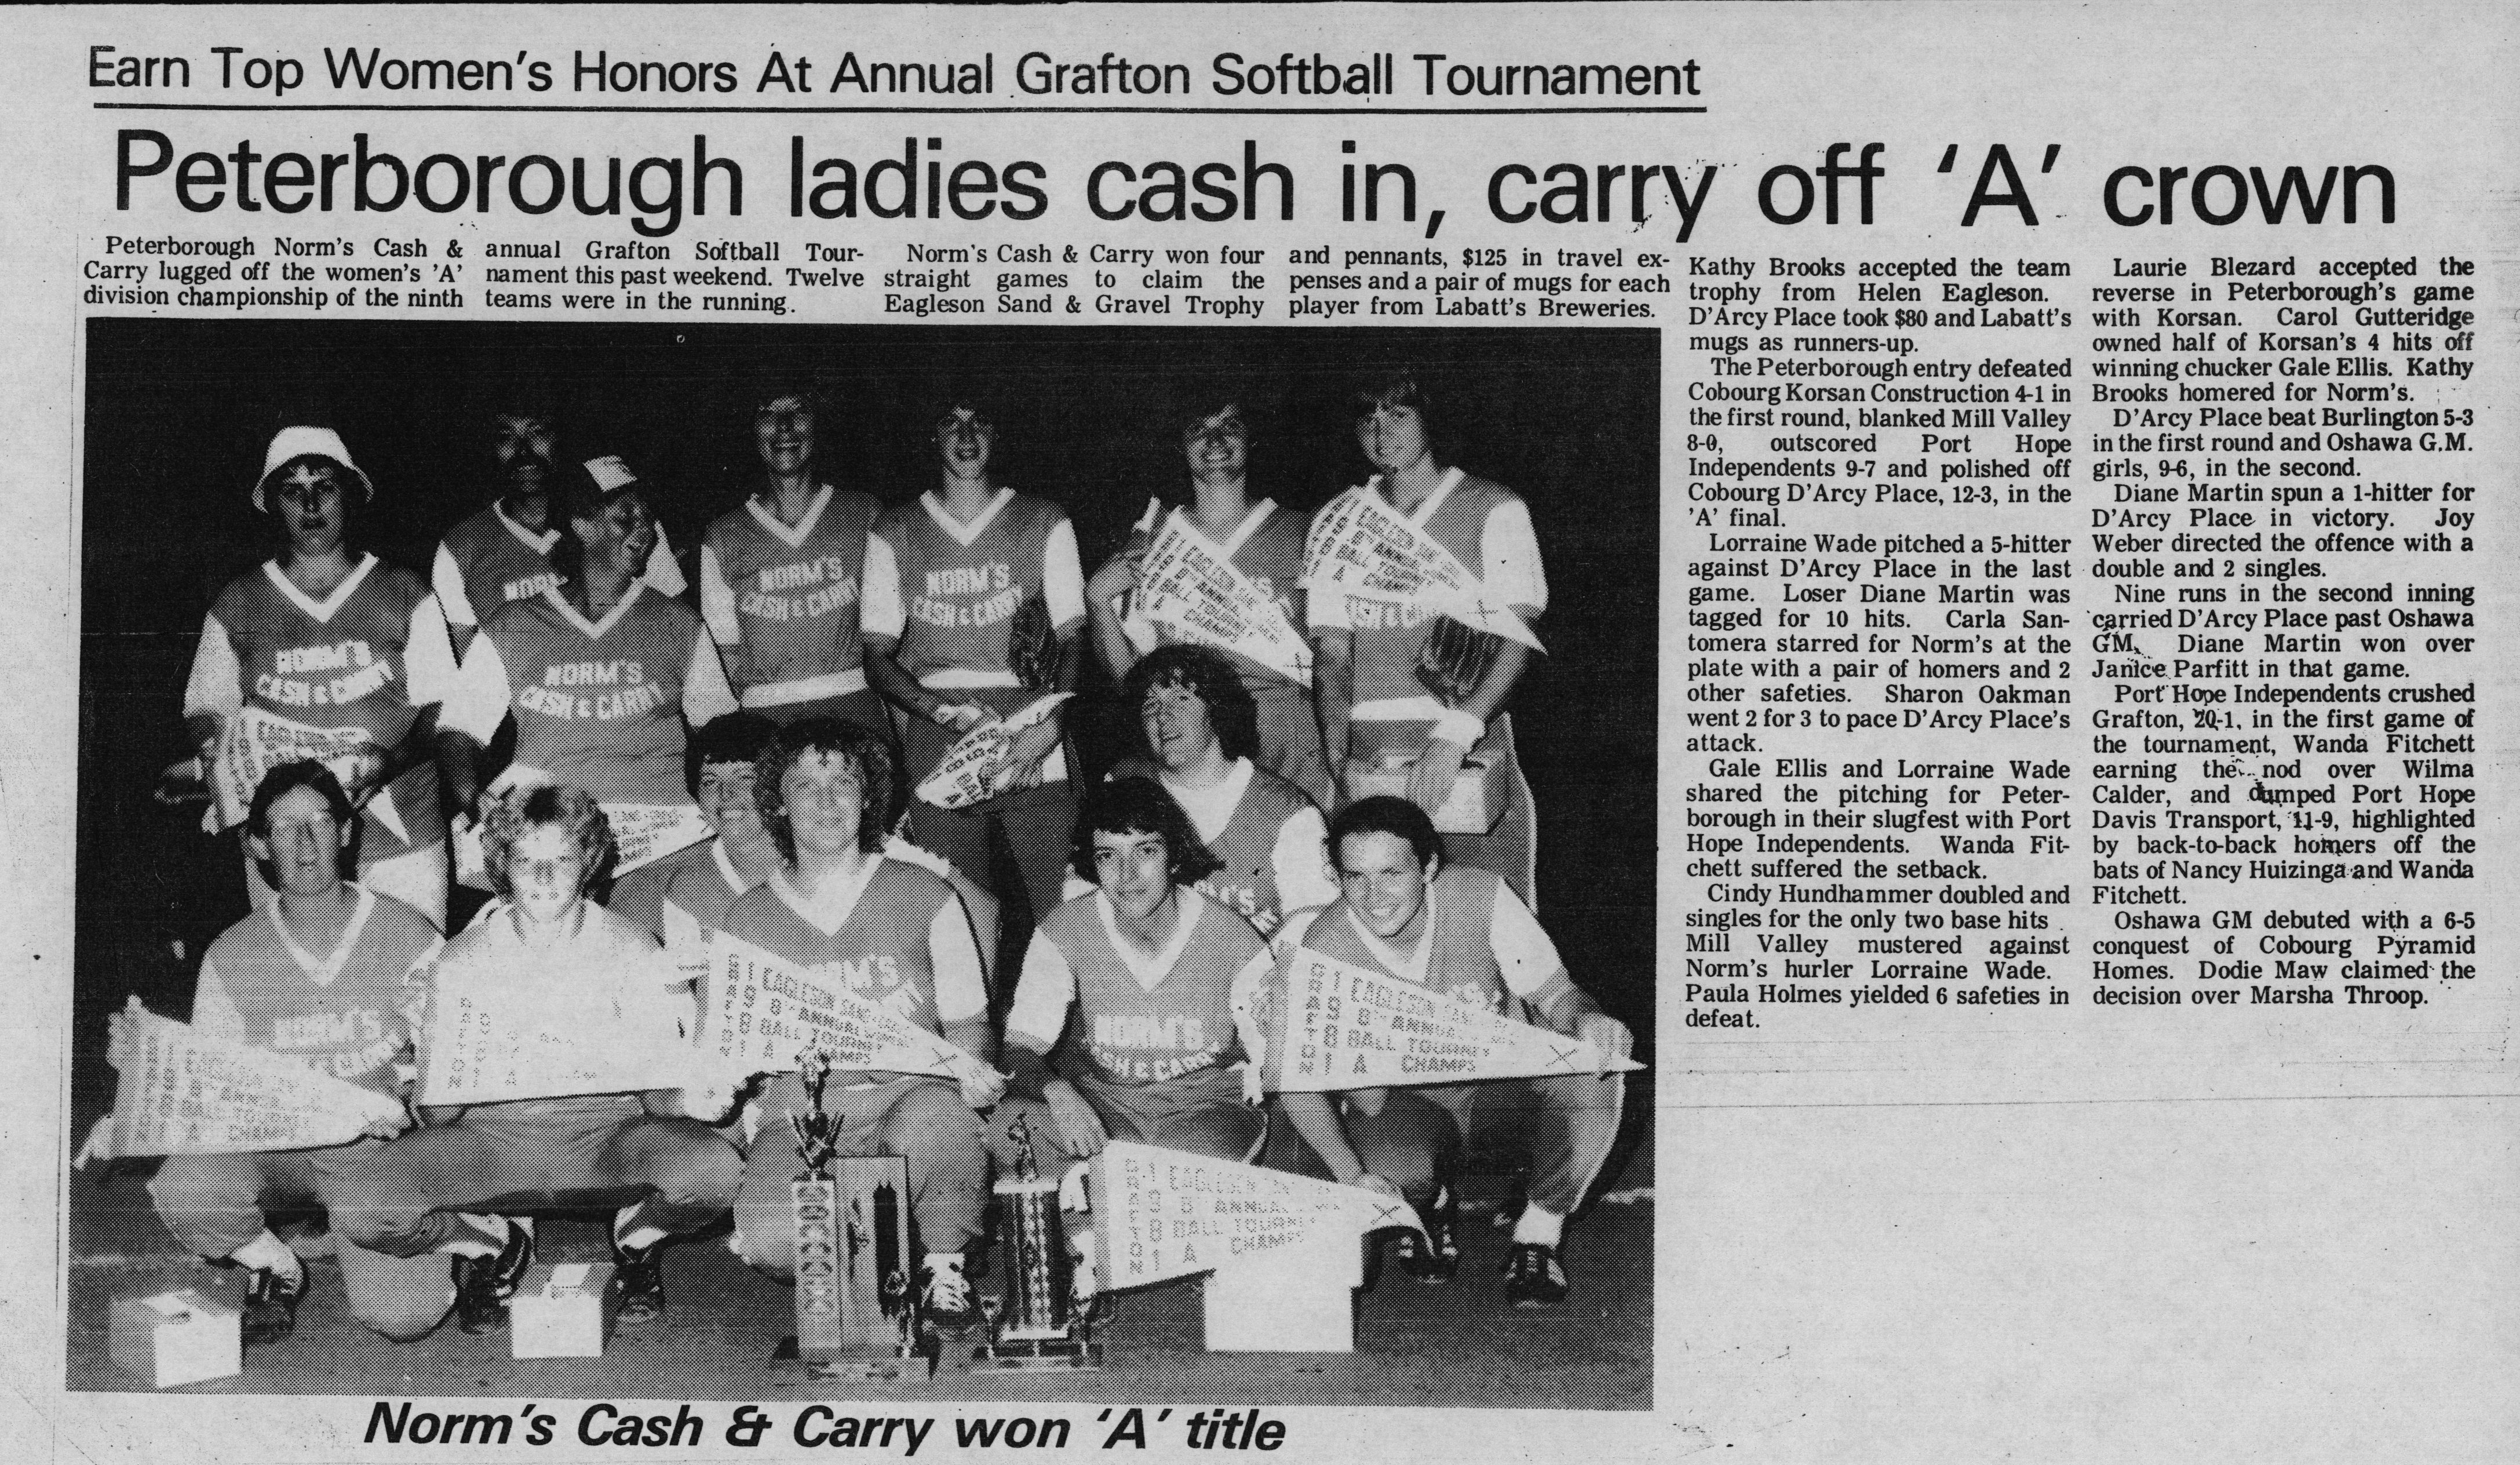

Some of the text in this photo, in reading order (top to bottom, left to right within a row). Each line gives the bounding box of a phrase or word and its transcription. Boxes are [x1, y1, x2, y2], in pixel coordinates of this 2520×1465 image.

[90, 46, 1700, 96] Earn Top Women's Honors At Annual Grafton Softball Tournament
[117, 128, 2395, 243] Peterborough ladies cash in, carry off 'A' crown
[106, 236, 462, 260] Peterborough Norm's Cash &
[1289, 245, 1669, 269] and pennants, $125 in travel ex-
[84, 261, 462, 285] Carry lugged off the women's 'A'
[1690, 257, 2070, 281] Kathy Brooks accepted the team
[2114, 256, 2474, 280] Laurie Blezard accepted the
[1290, 271, 1670, 296] penses and a pair of mugs for each
[84, 285, 463, 310] division championship of the ninth
[1289, 296, 1655, 318] player from Labatt's Breweries.
[1690, 336, 1918, 356] mugs as runners-up.
[2114, 407, 2473, 431] D'Arcy Place beat Burlington 5-3
[1687, 433, 2071, 457] 8-0, outscored Port Hope
[1710, 533, 2071, 557] Lorraine Wade pitched a 5-hitter
[926, 561, 1010, 596] NORM'S
[2115, 582, 2474, 606] Nine runs in the second inning
[542, 659, 643, 686] NORM'S
[1709, 759, 2070, 778] Gale Ellis and Lorraine Wade
[1686, 933, 2070, 959] Mill Valley mustered against
[2093, 935, 2475, 959] conquest of Cobourg Pyramid
[2094, 985, 2427, 1009] decision over Marsha Throop.
[1686, 1008, 1759, 1027] defeat.
[1347, 1027, 1396, 1052] BALL
[1352, 1053, 1476, 1074] A CHAMPS
[364, 1402, 1286, 1456] Norm's Cash & Carry won 'A' title
